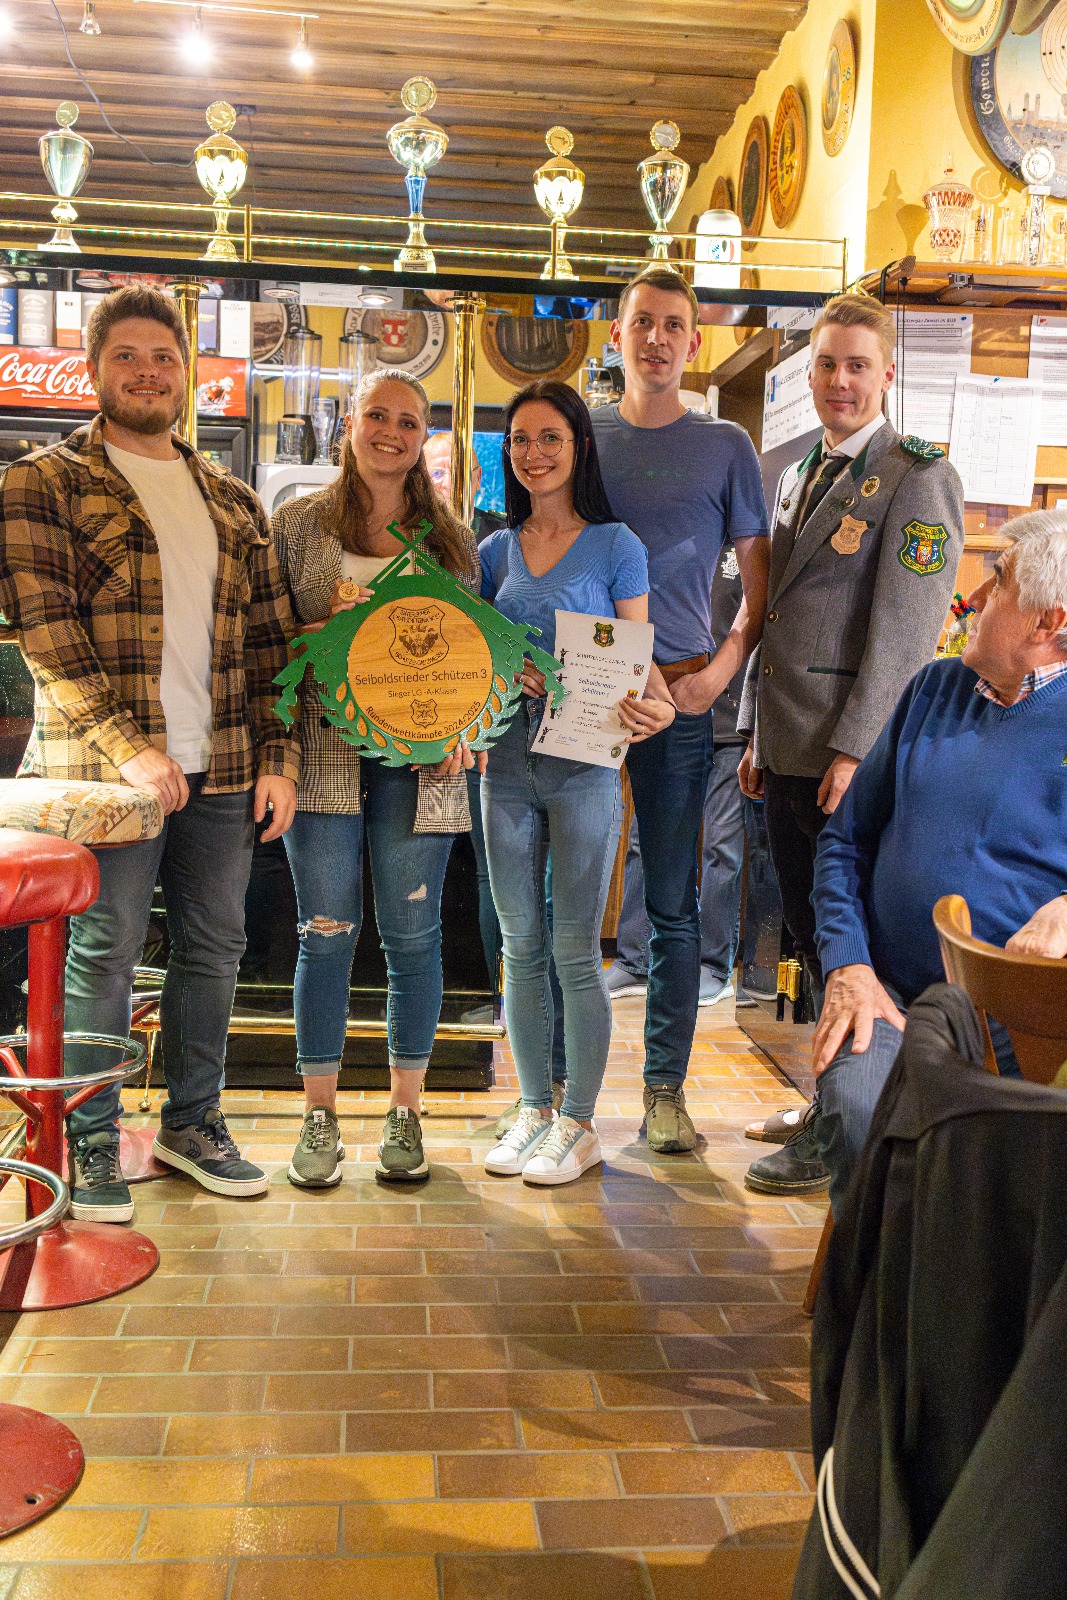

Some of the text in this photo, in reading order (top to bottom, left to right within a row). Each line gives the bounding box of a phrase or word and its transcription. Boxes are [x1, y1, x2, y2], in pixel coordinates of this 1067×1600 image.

[355, 668, 487, 686] Seiboldsrieder Schützen 3
[388, 690, 410, 698] Sieger
[366, 700, 481, 739] Rundenwettkämpfe 2024/2025
